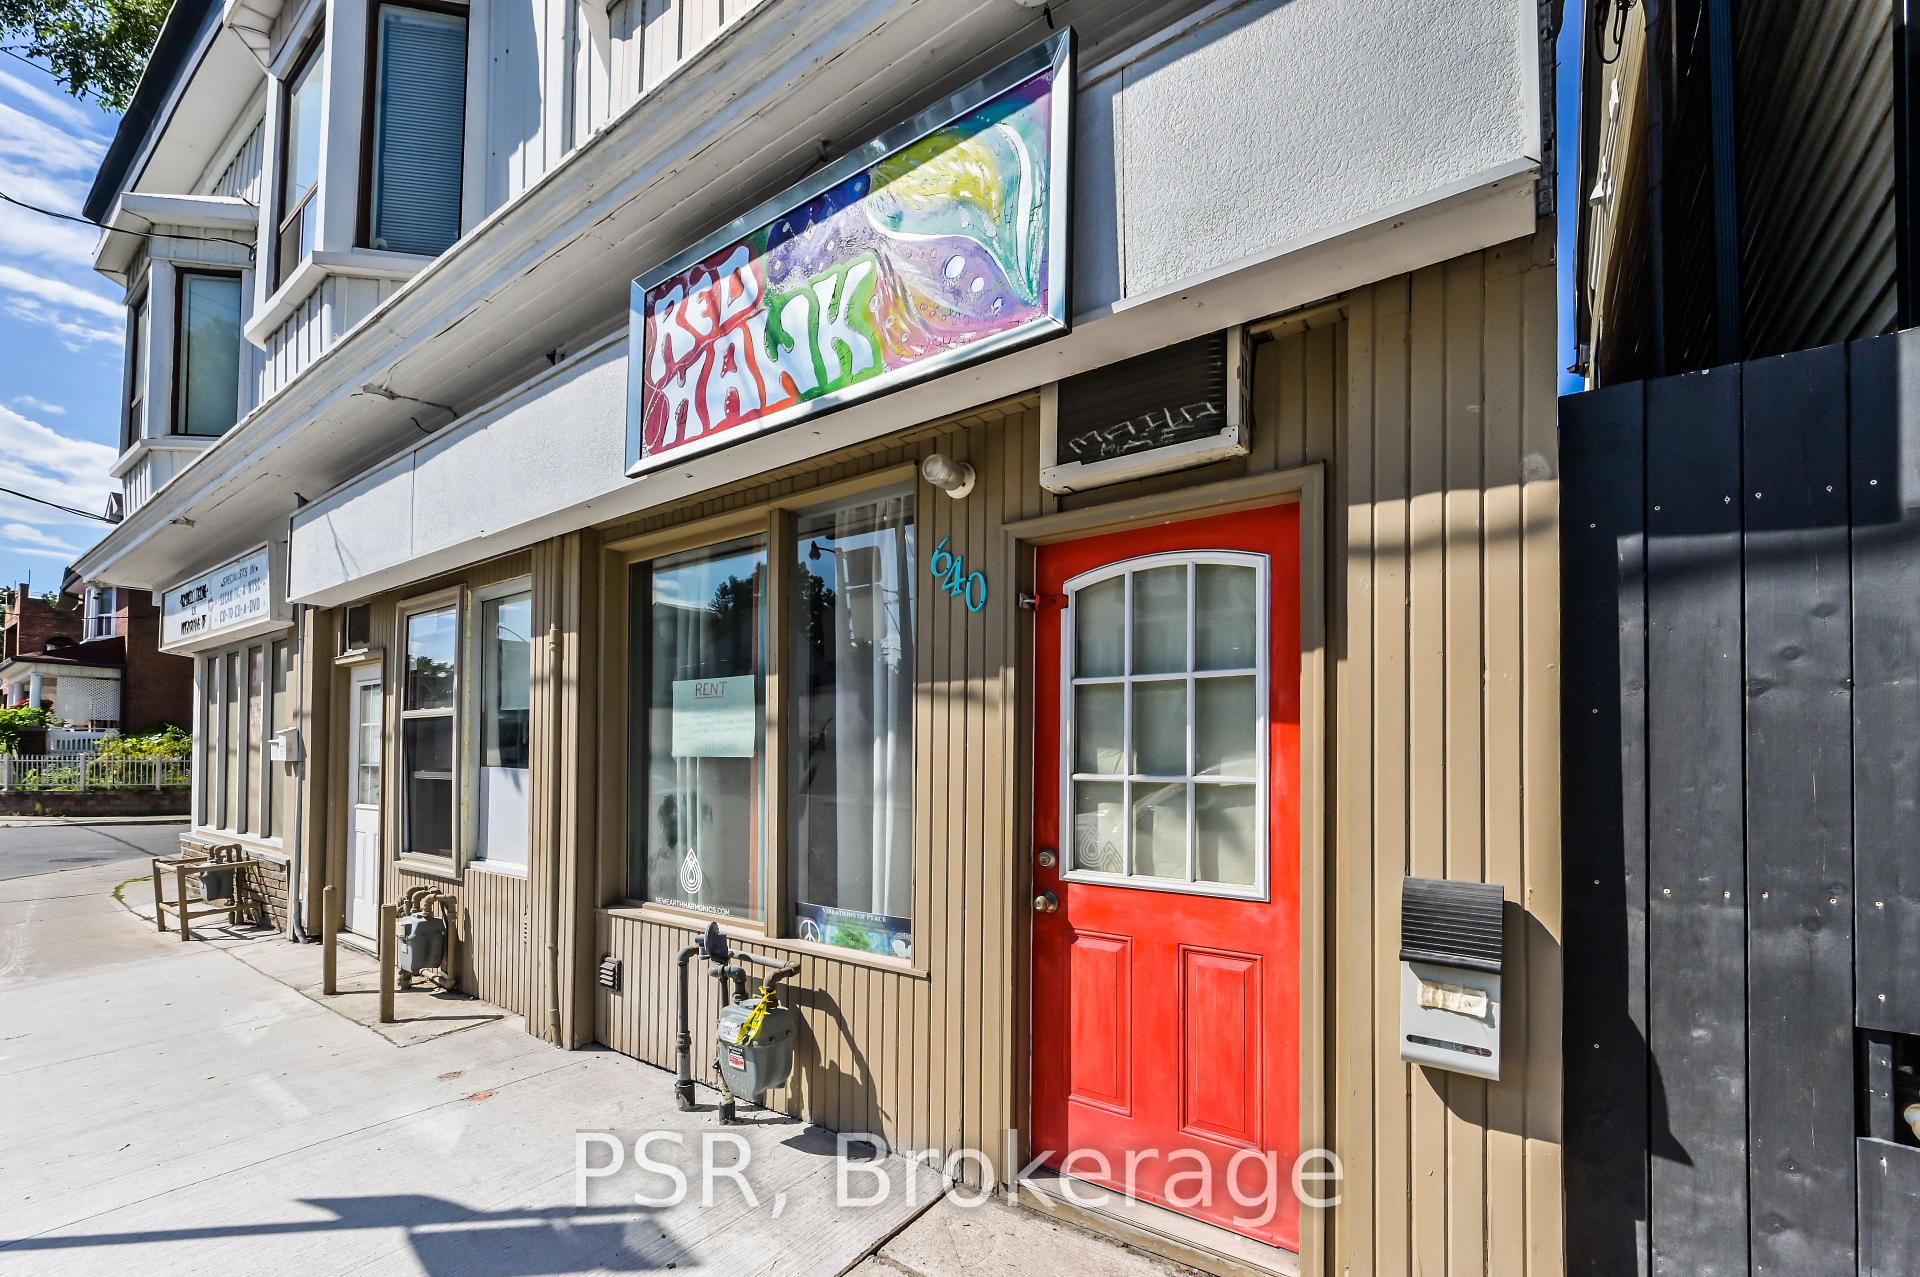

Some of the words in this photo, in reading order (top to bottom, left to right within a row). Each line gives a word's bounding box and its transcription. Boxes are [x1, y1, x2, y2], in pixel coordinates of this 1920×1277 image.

[651, 244, 756, 383] RED
[656, 256, 880, 449] HAWK
[930, 536, 988, 613] 640
[695, 681, 728, 697] RENT
[866, 913, 887, 923] PEACE
